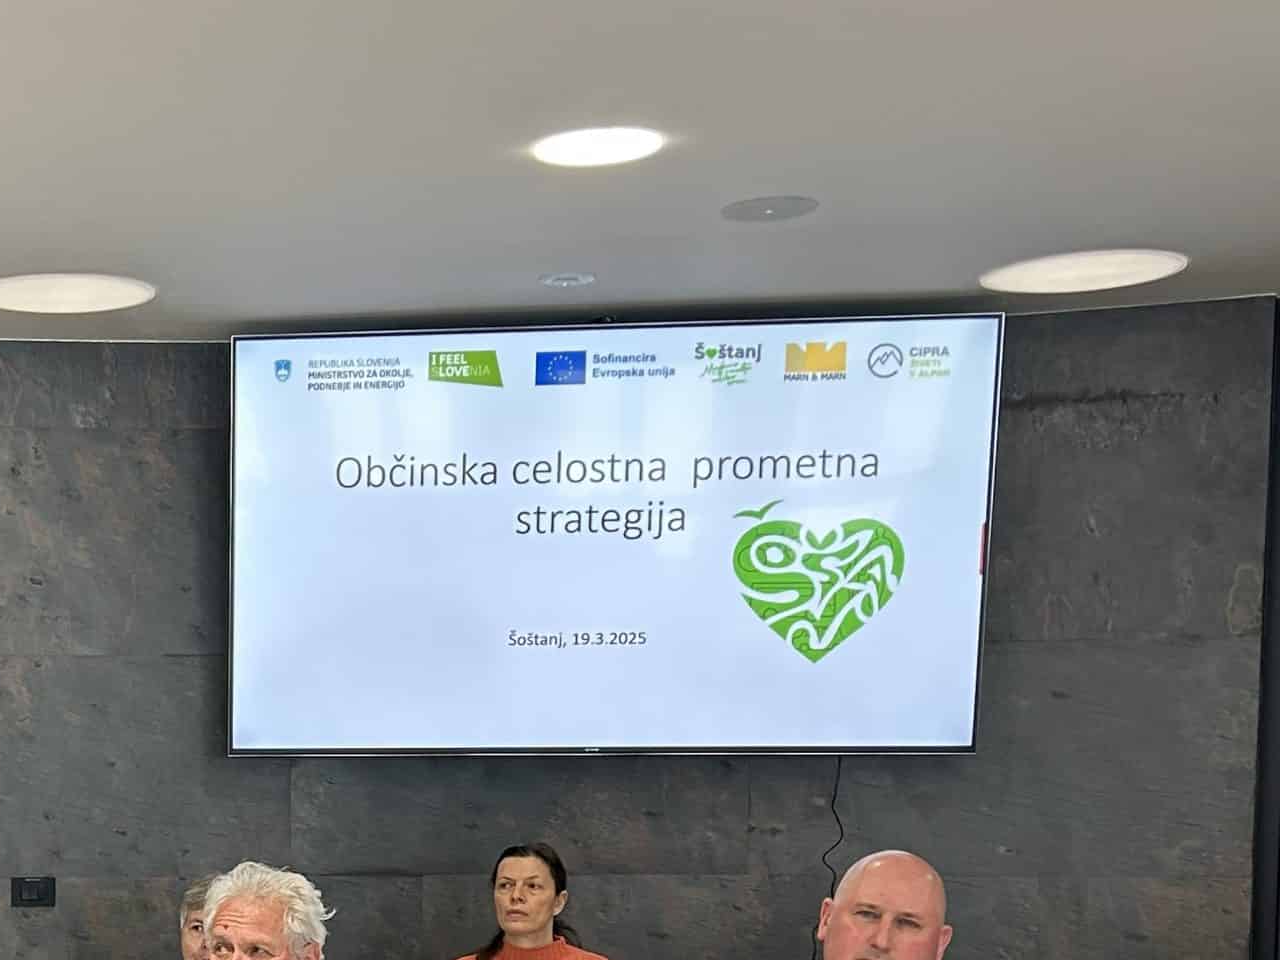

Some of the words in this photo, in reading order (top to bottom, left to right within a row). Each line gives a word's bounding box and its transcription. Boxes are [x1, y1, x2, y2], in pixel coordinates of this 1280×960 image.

[909, 346, 950, 357] CIPRA
[308, 358, 355, 369] REPUBLIKA
[356, 357, 401, 368] SLOVENIJA
[431, 354, 438, 365] I
[440, 353, 468, 364] FEEL
[592, 352, 657, 364] Sofinancira
[308, 369, 365, 380] MINISTRSTVO
[366, 368, 378, 378] ZA
[592, 367, 645, 379] Evropska
[647, 366, 676, 378] unija
[307, 381, 352, 392] PODNEBJE
[353, 380, 362, 390] IN
[363, 379, 405, 391] ENERGIJO
[336, 452, 498, 488] Občinska
[512, 449, 666, 485] celostna
[693, 449, 879, 488] prometna
[516, 500, 686, 540] strategija
[508, 629, 567, 648] Šoštanj,
[573, 632, 647, 646] 19.3.2025
